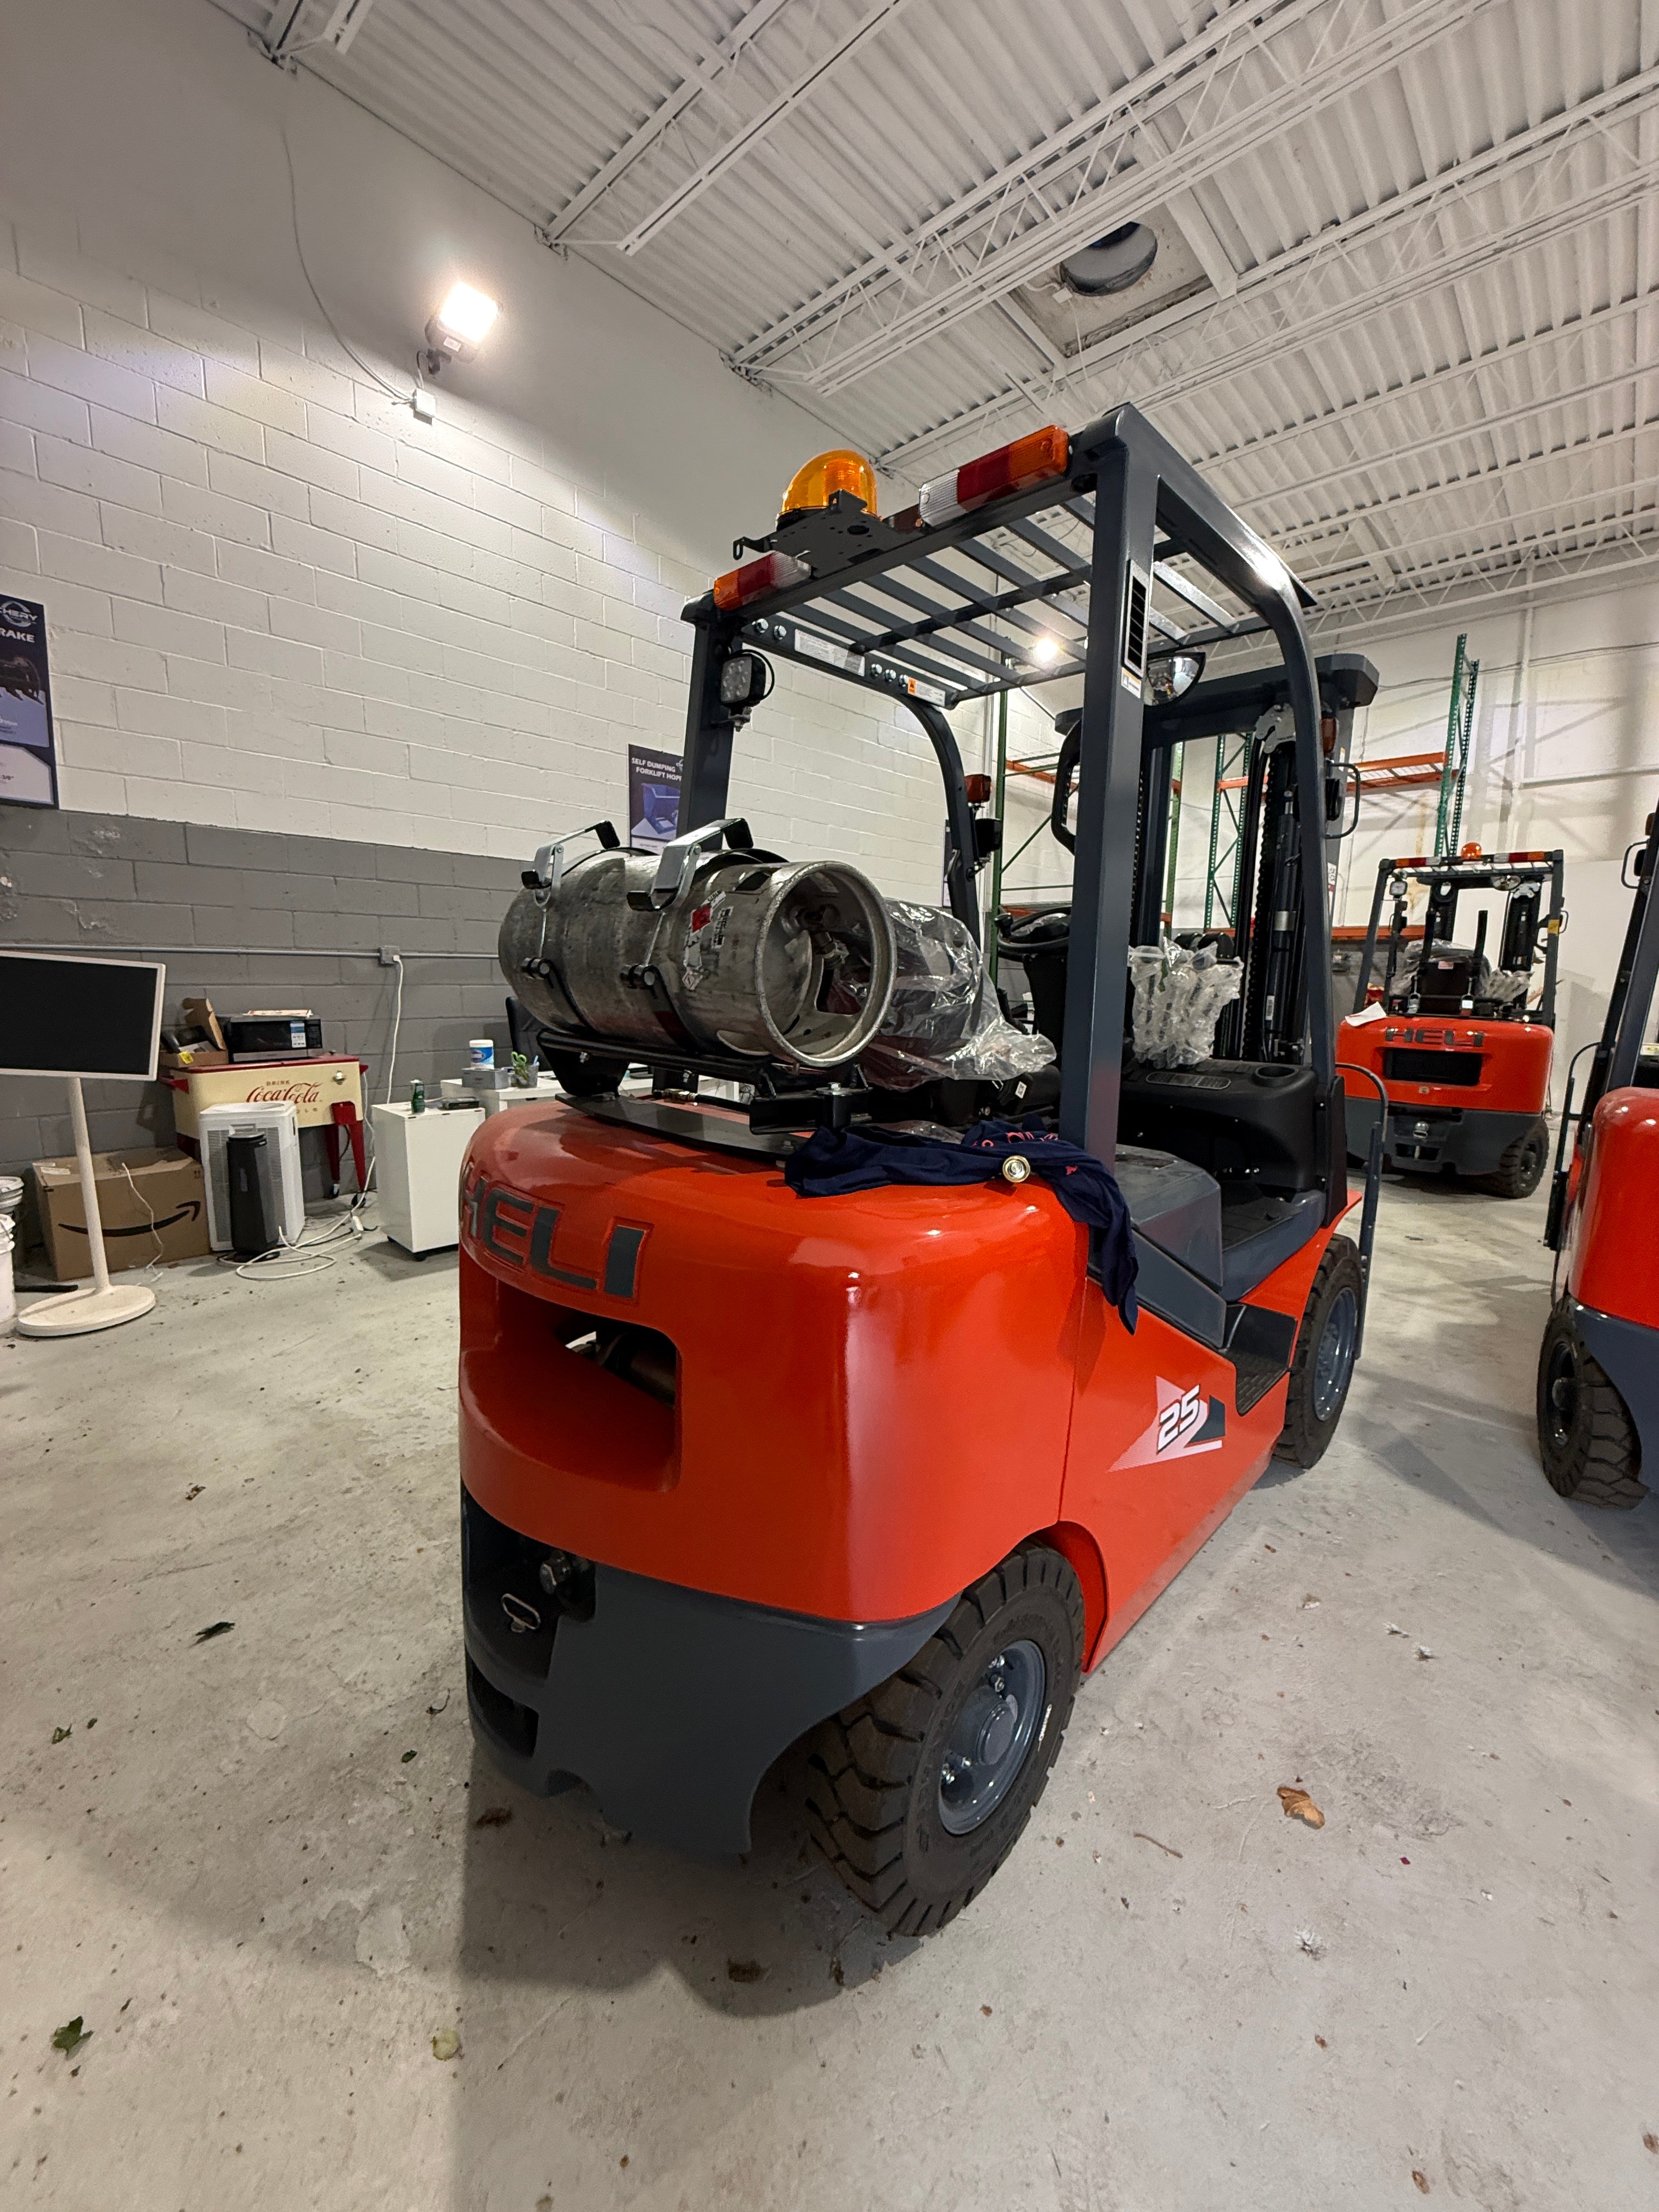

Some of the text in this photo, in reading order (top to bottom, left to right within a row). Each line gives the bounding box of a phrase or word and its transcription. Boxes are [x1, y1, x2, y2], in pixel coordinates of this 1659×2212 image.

[631, 757, 646, 766] SELF
[647, 761, 676, 772] DUMPING
[636, 766, 665, 778] FORKLIFT
[1385, 1026, 1485, 1047] HELI
[459, 1160, 648, 1299] HELI
[1156, 1384, 1201, 1455] 25
